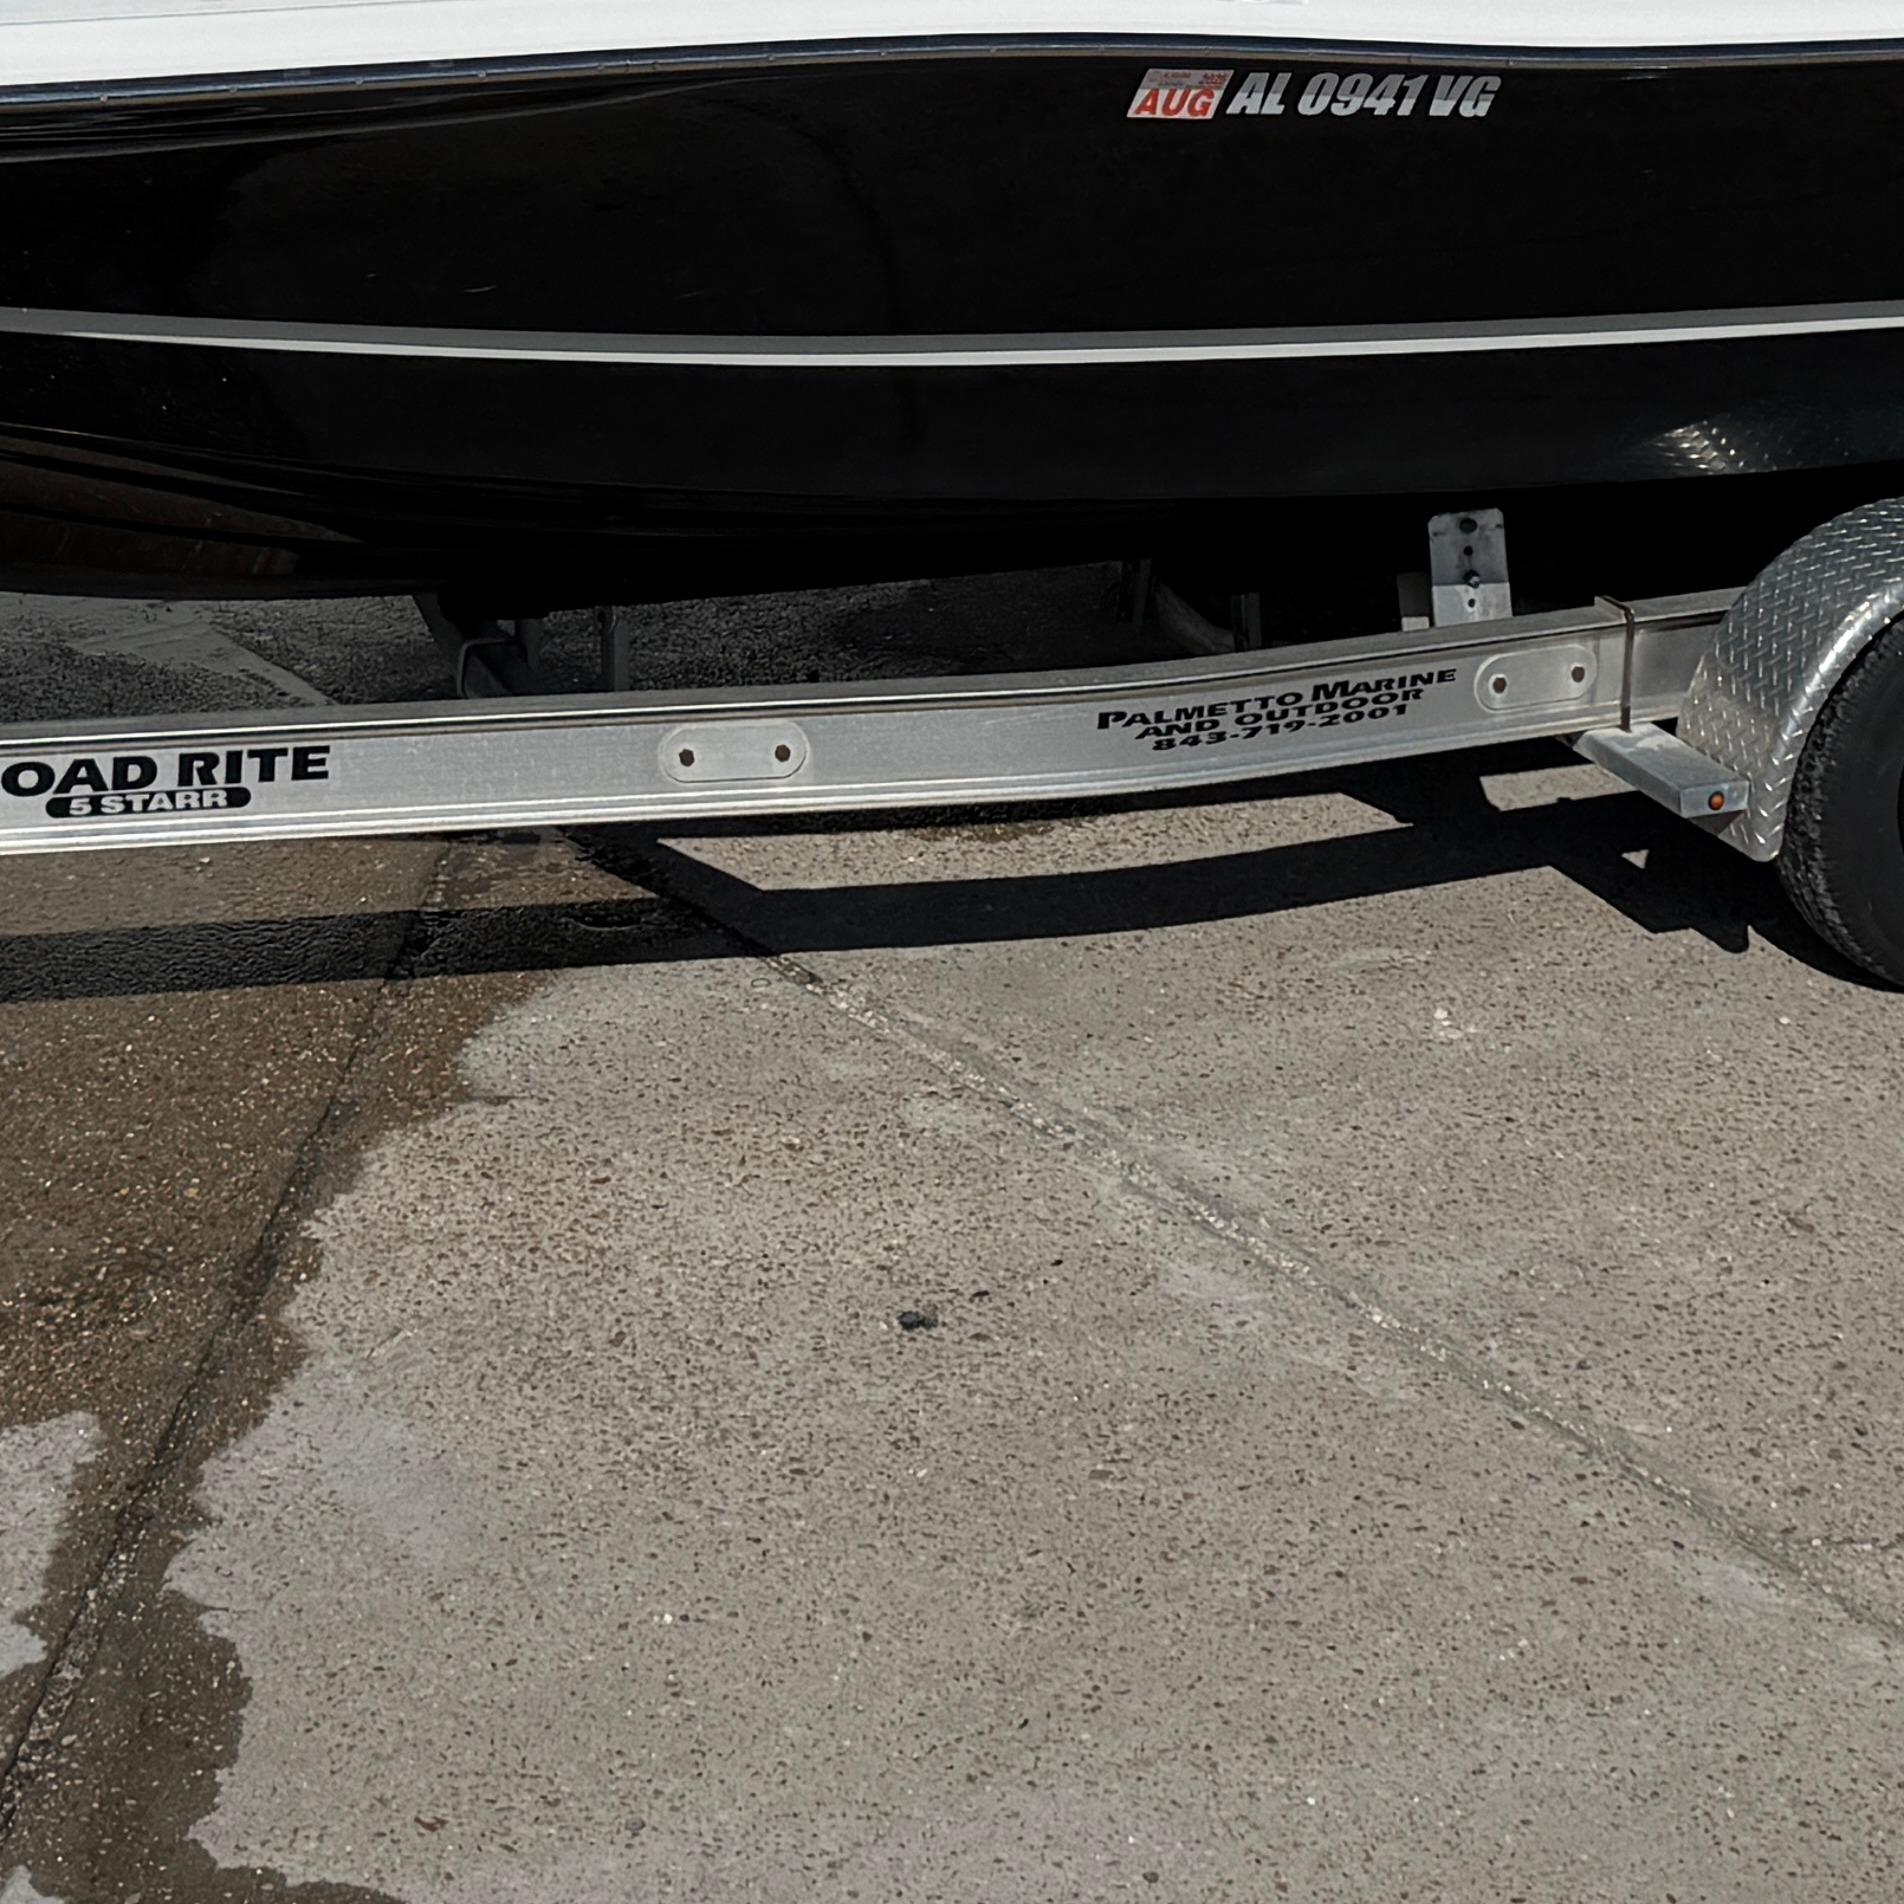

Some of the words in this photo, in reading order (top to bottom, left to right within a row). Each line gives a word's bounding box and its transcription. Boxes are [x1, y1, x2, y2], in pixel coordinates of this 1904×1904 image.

[1135, 88, 1215, 117] AUG
[1226, 72, 1292, 115] AL
[1297, 73, 1429, 116] 0941
[1428, 75, 1501, 117] VG
[1097, 692, 1303, 730] PALMETTO
[1311, 669, 1457, 701] MARINE
[1135, 718, 1220, 739] AND
[1234, 688, 1424, 725] OUTDOOR
[1152, 705, 1408, 751] 843-719-2001
[177, 745, 330, 787] RITE
[68, 797, 92, 815] 5
[100, 789, 228, 813] STARR
